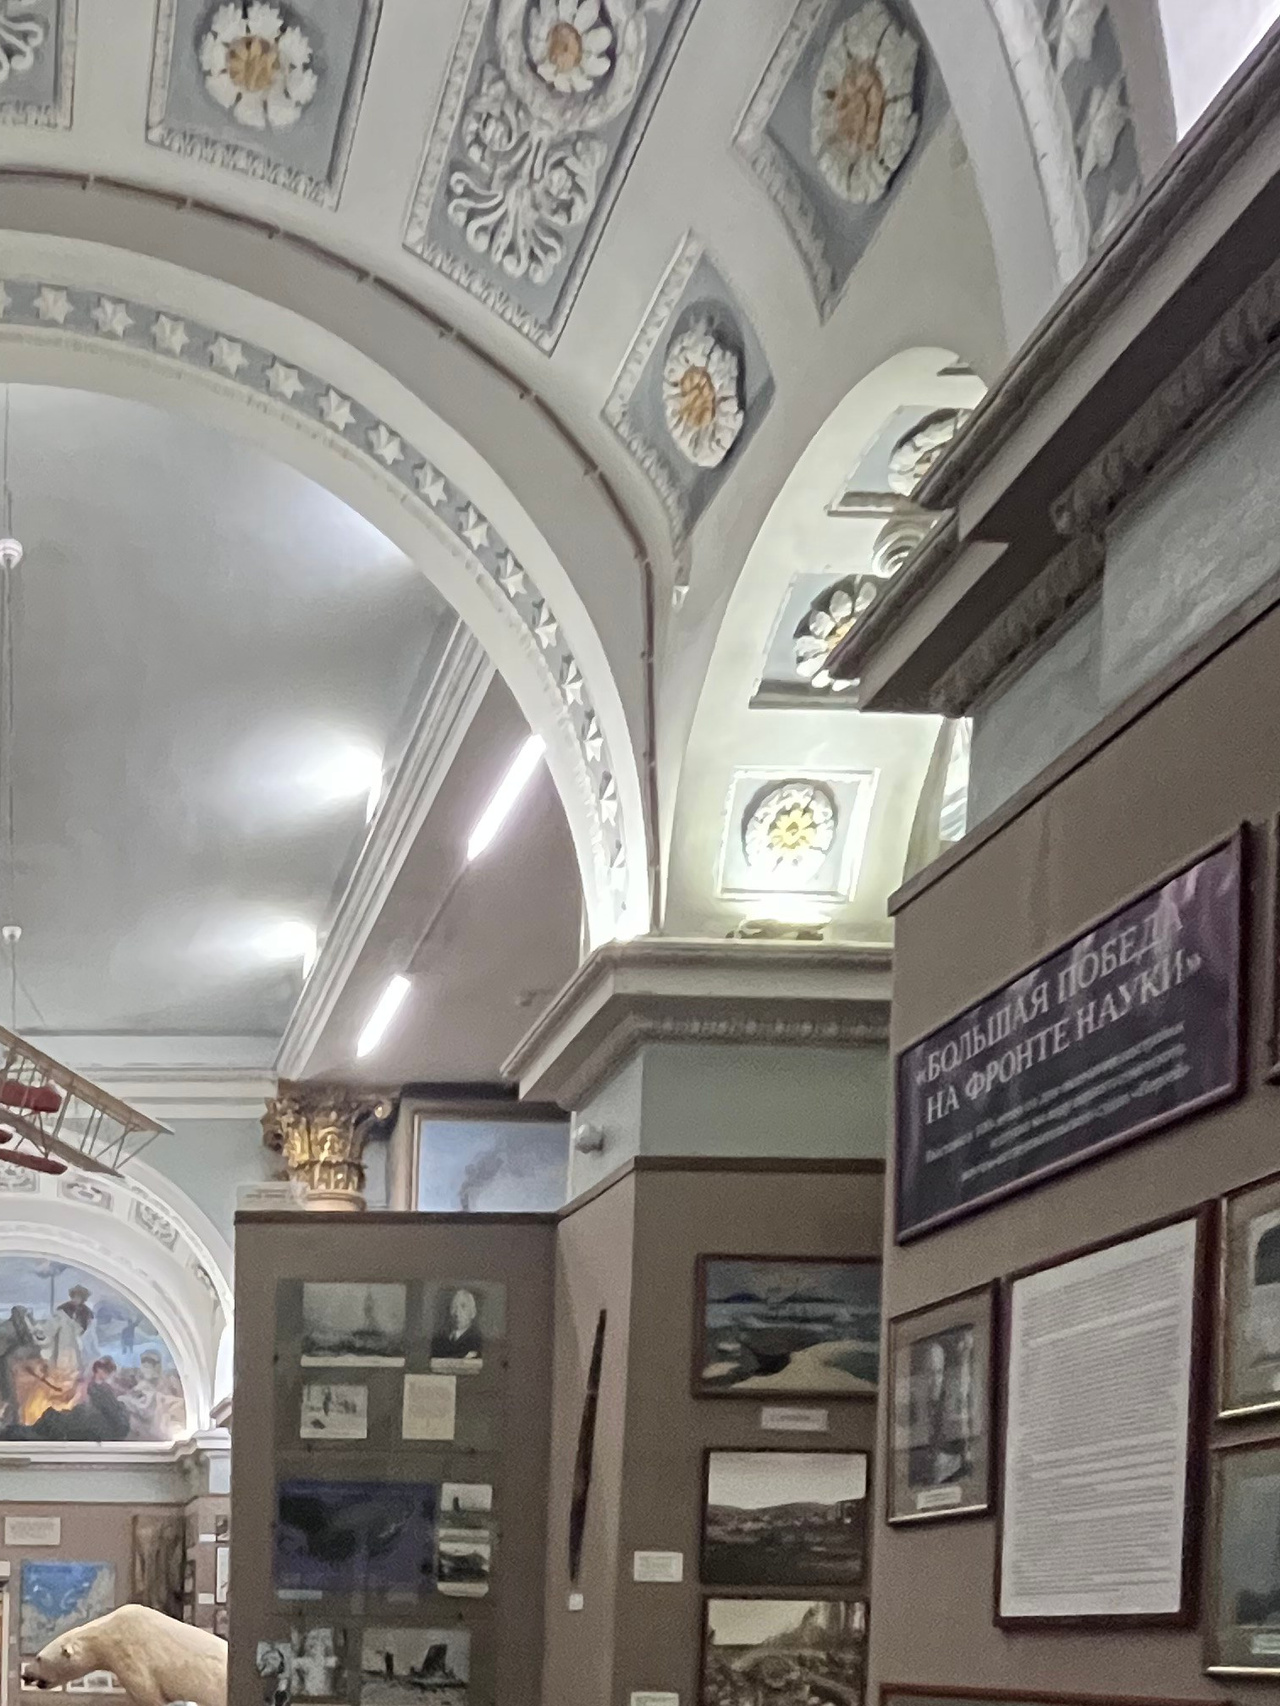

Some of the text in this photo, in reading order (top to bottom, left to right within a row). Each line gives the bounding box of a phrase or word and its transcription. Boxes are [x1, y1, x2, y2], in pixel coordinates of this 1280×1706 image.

[916, 981, 1049, 1083] «БОЛЬШАЯ
[926, 1085, 960, 1124] НА
[964, 1017, 1070, 1100] ФРОНТЕ
[1077, 949, 1202, 1040] НАУКИ»
